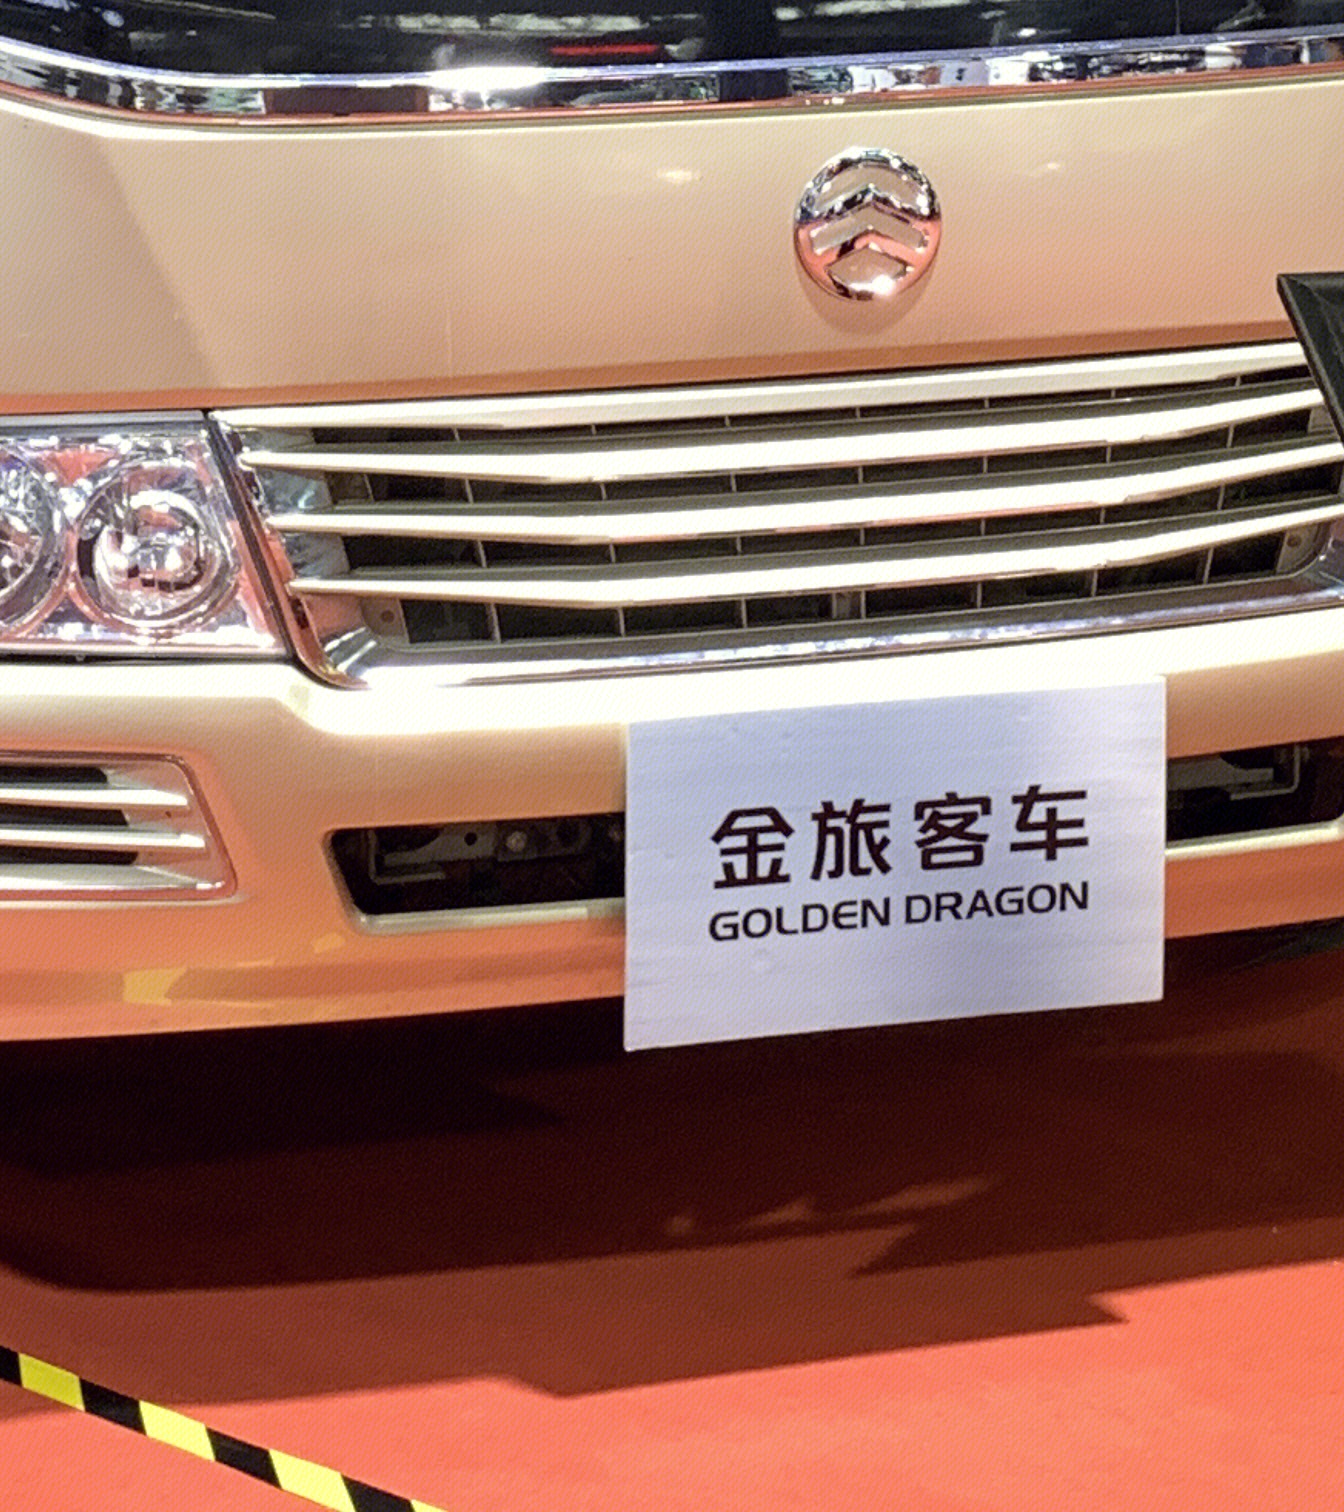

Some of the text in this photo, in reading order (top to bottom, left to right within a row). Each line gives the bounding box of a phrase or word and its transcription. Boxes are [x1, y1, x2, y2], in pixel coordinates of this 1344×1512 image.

[711, 784, 1089, 890] 金旅客车
[708, 881, 1089, 942] GOLDEN DRAGON
